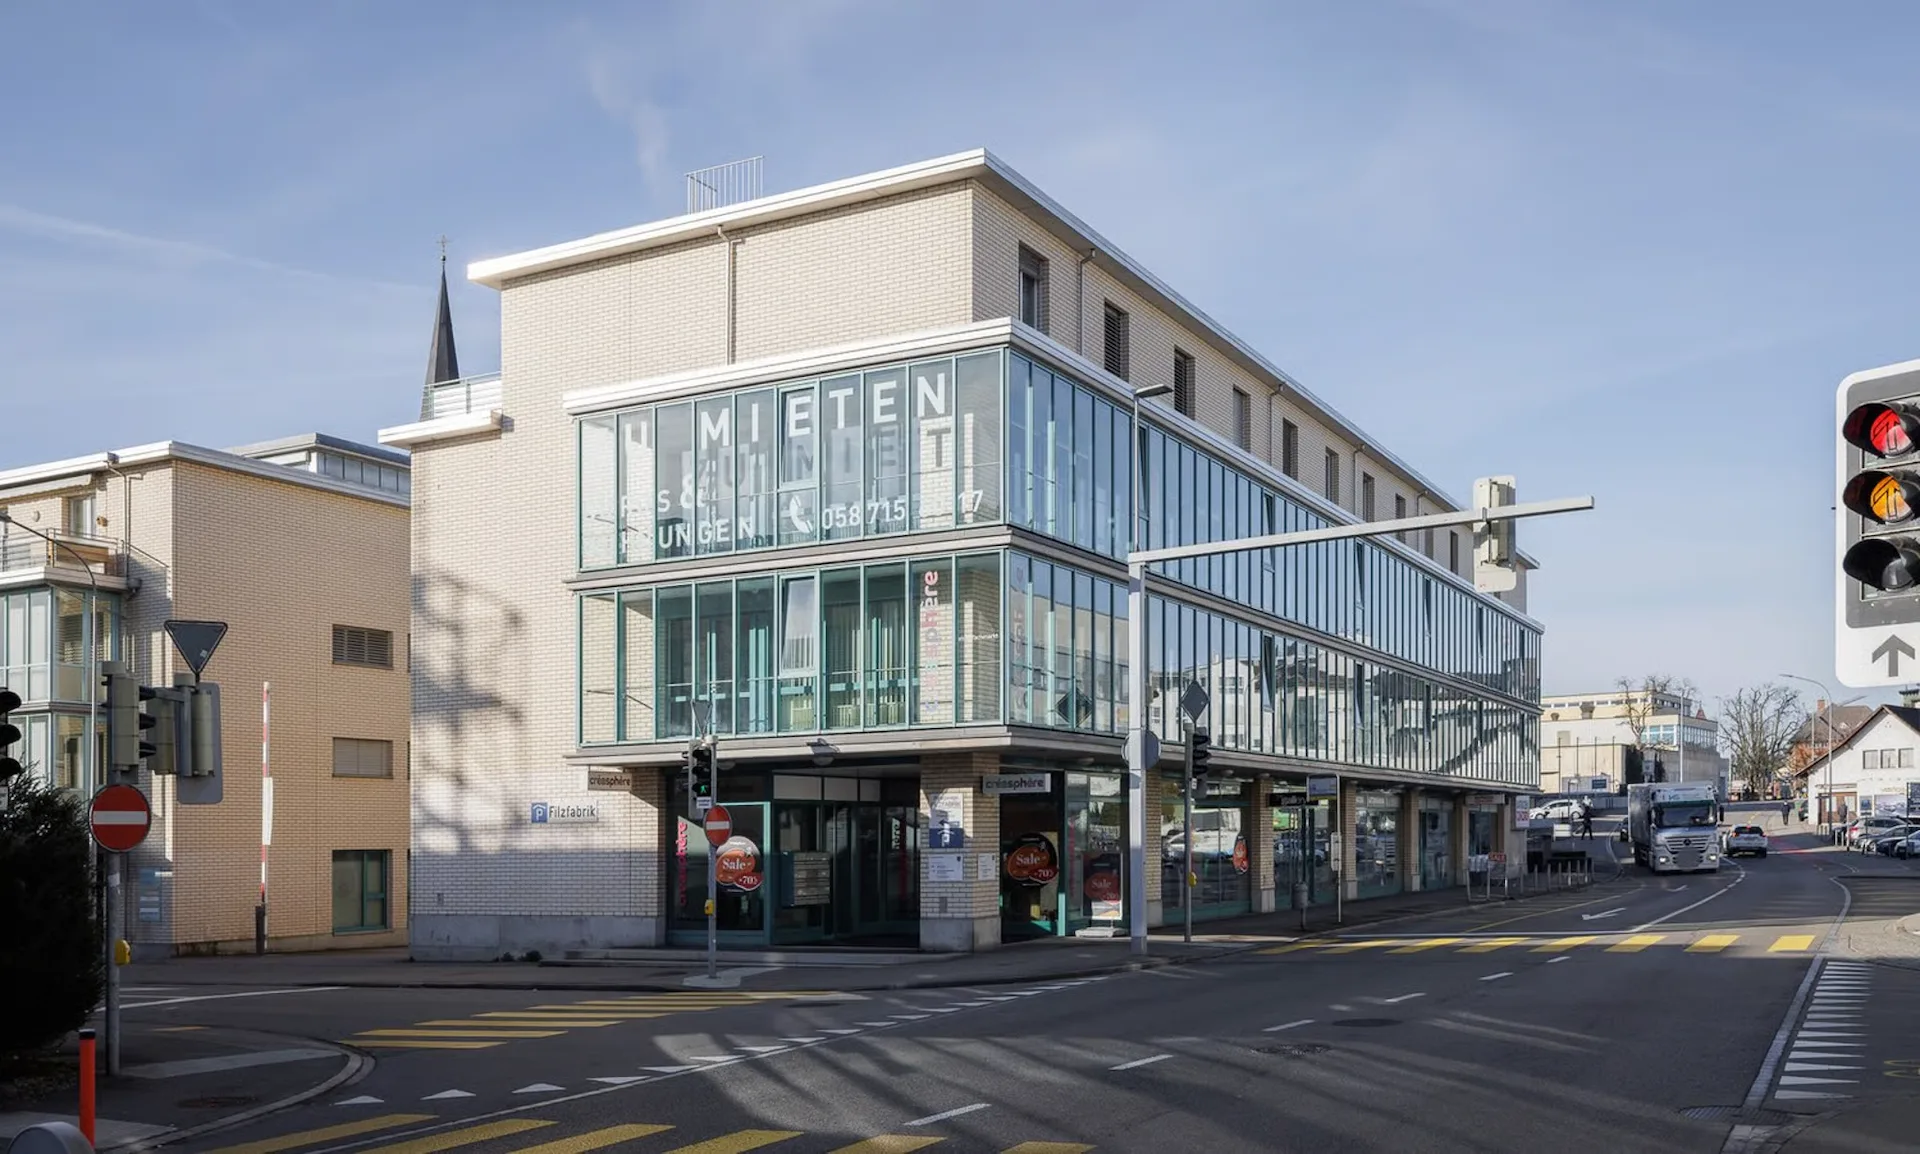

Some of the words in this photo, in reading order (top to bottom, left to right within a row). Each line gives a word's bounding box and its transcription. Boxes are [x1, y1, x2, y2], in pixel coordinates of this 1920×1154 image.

[700, 372, 946, 450] MIETEN
[821, 504, 861, 531] 058
[866, 499, 906, 525] 715
[548, 805, 597, 818] Filzfabrik
[722, 858, 747, 871] Sale
[1015, 852, 1041, 866] Sale
